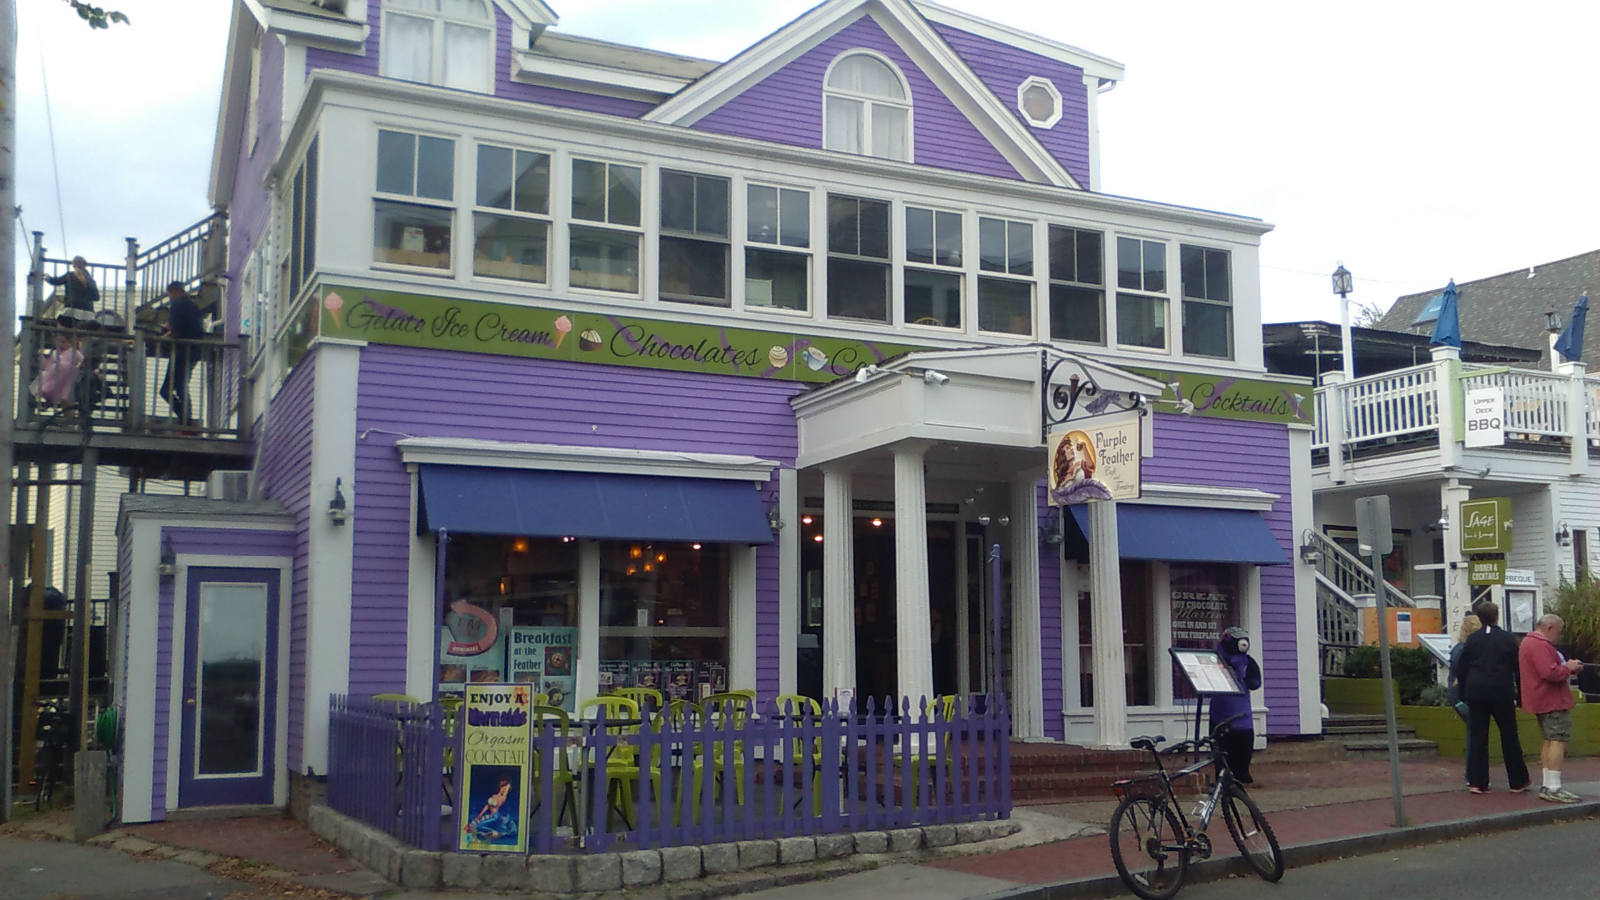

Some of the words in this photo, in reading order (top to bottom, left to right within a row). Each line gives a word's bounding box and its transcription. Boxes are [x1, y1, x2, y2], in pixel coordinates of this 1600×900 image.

[346, 301, 425, 333] Gelato
[432, 306, 469, 338] Ice
[475, 312, 551, 345] Cream
[610, 324, 762, 367] Chocolates
[1190, 383, 1289, 415] Cocktails
[1468, 417, 1501, 431] BBQ
[1095, 431, 1127, 450] Purple
[1099, 448, 1134, 466] Feather
[514, 632, 572, 644] Breakfast
[513, 647, 521, 656] at
[524, 646, 537, 656] the
[513, 659, 541, 672] Feather
[470, 693, 512, 706] ENJOY
[514, 693, 524, 704] A
[467, 730, 525, 748] Orgasm
[466, 750, 526, 764] COCKTAIL
